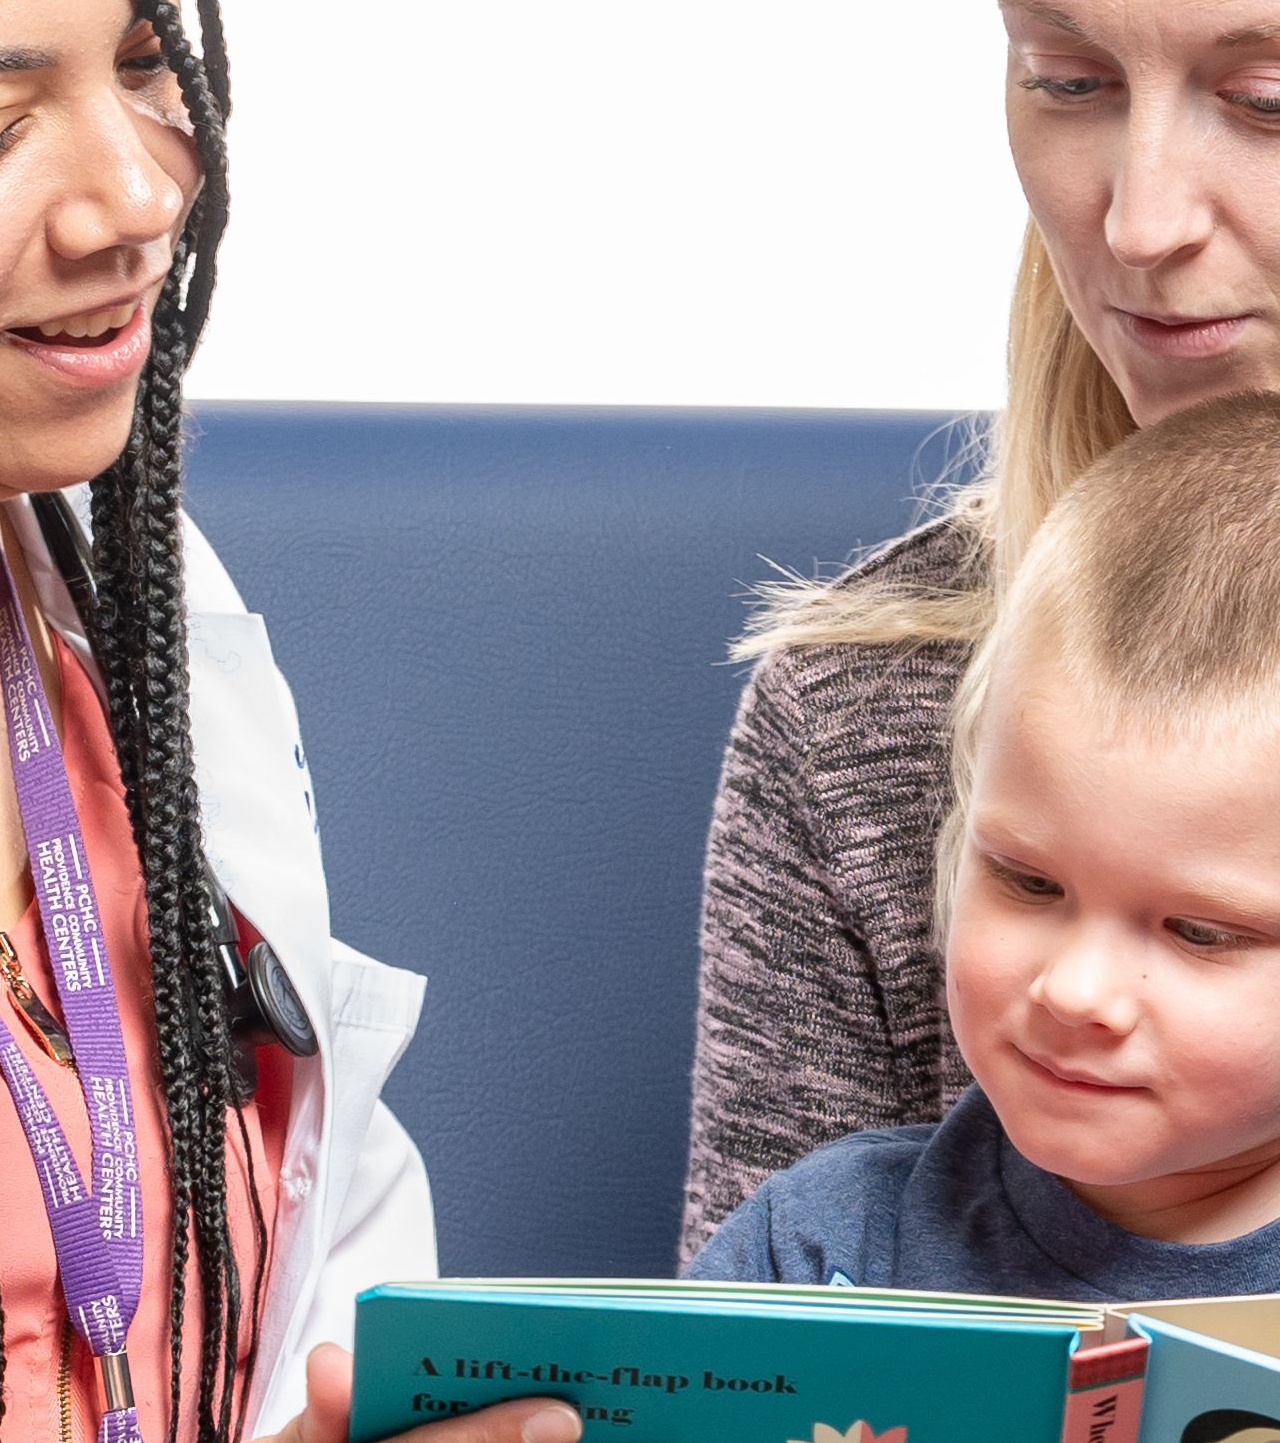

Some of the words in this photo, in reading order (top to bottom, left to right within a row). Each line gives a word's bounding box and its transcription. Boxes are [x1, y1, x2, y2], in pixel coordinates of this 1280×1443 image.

[19, 646, 37, 695] PCHC
[7, 685, 31, 762] CENTERS
[16, 680, 40, 754] COMMUNITY
[37, 841, 63, 910] HEALTH
[52, 913, 81, 992] CENTERS
[52, 838, 75, 910] PROVIDENCE
[69, 914, 92, 989] COMMUNITY
[76, 884, 97, 933] PCHC
[90, 1076, 112, 1148] HEALTH
[105, 1077, 123, 1153] PROVIDENCE
[50, 1127, 82, 1202] HEALTH
[123, 1131, 138, 1182] PCHC
[113, 1157, 124, 1239] COMMUNITY
[412, 1393, 469, 1413] for
[414, 1357, 439, 1377] A
[455, 1358, 689, 1394] lift-the-flap
[703, 1371, 798, 1394] book
